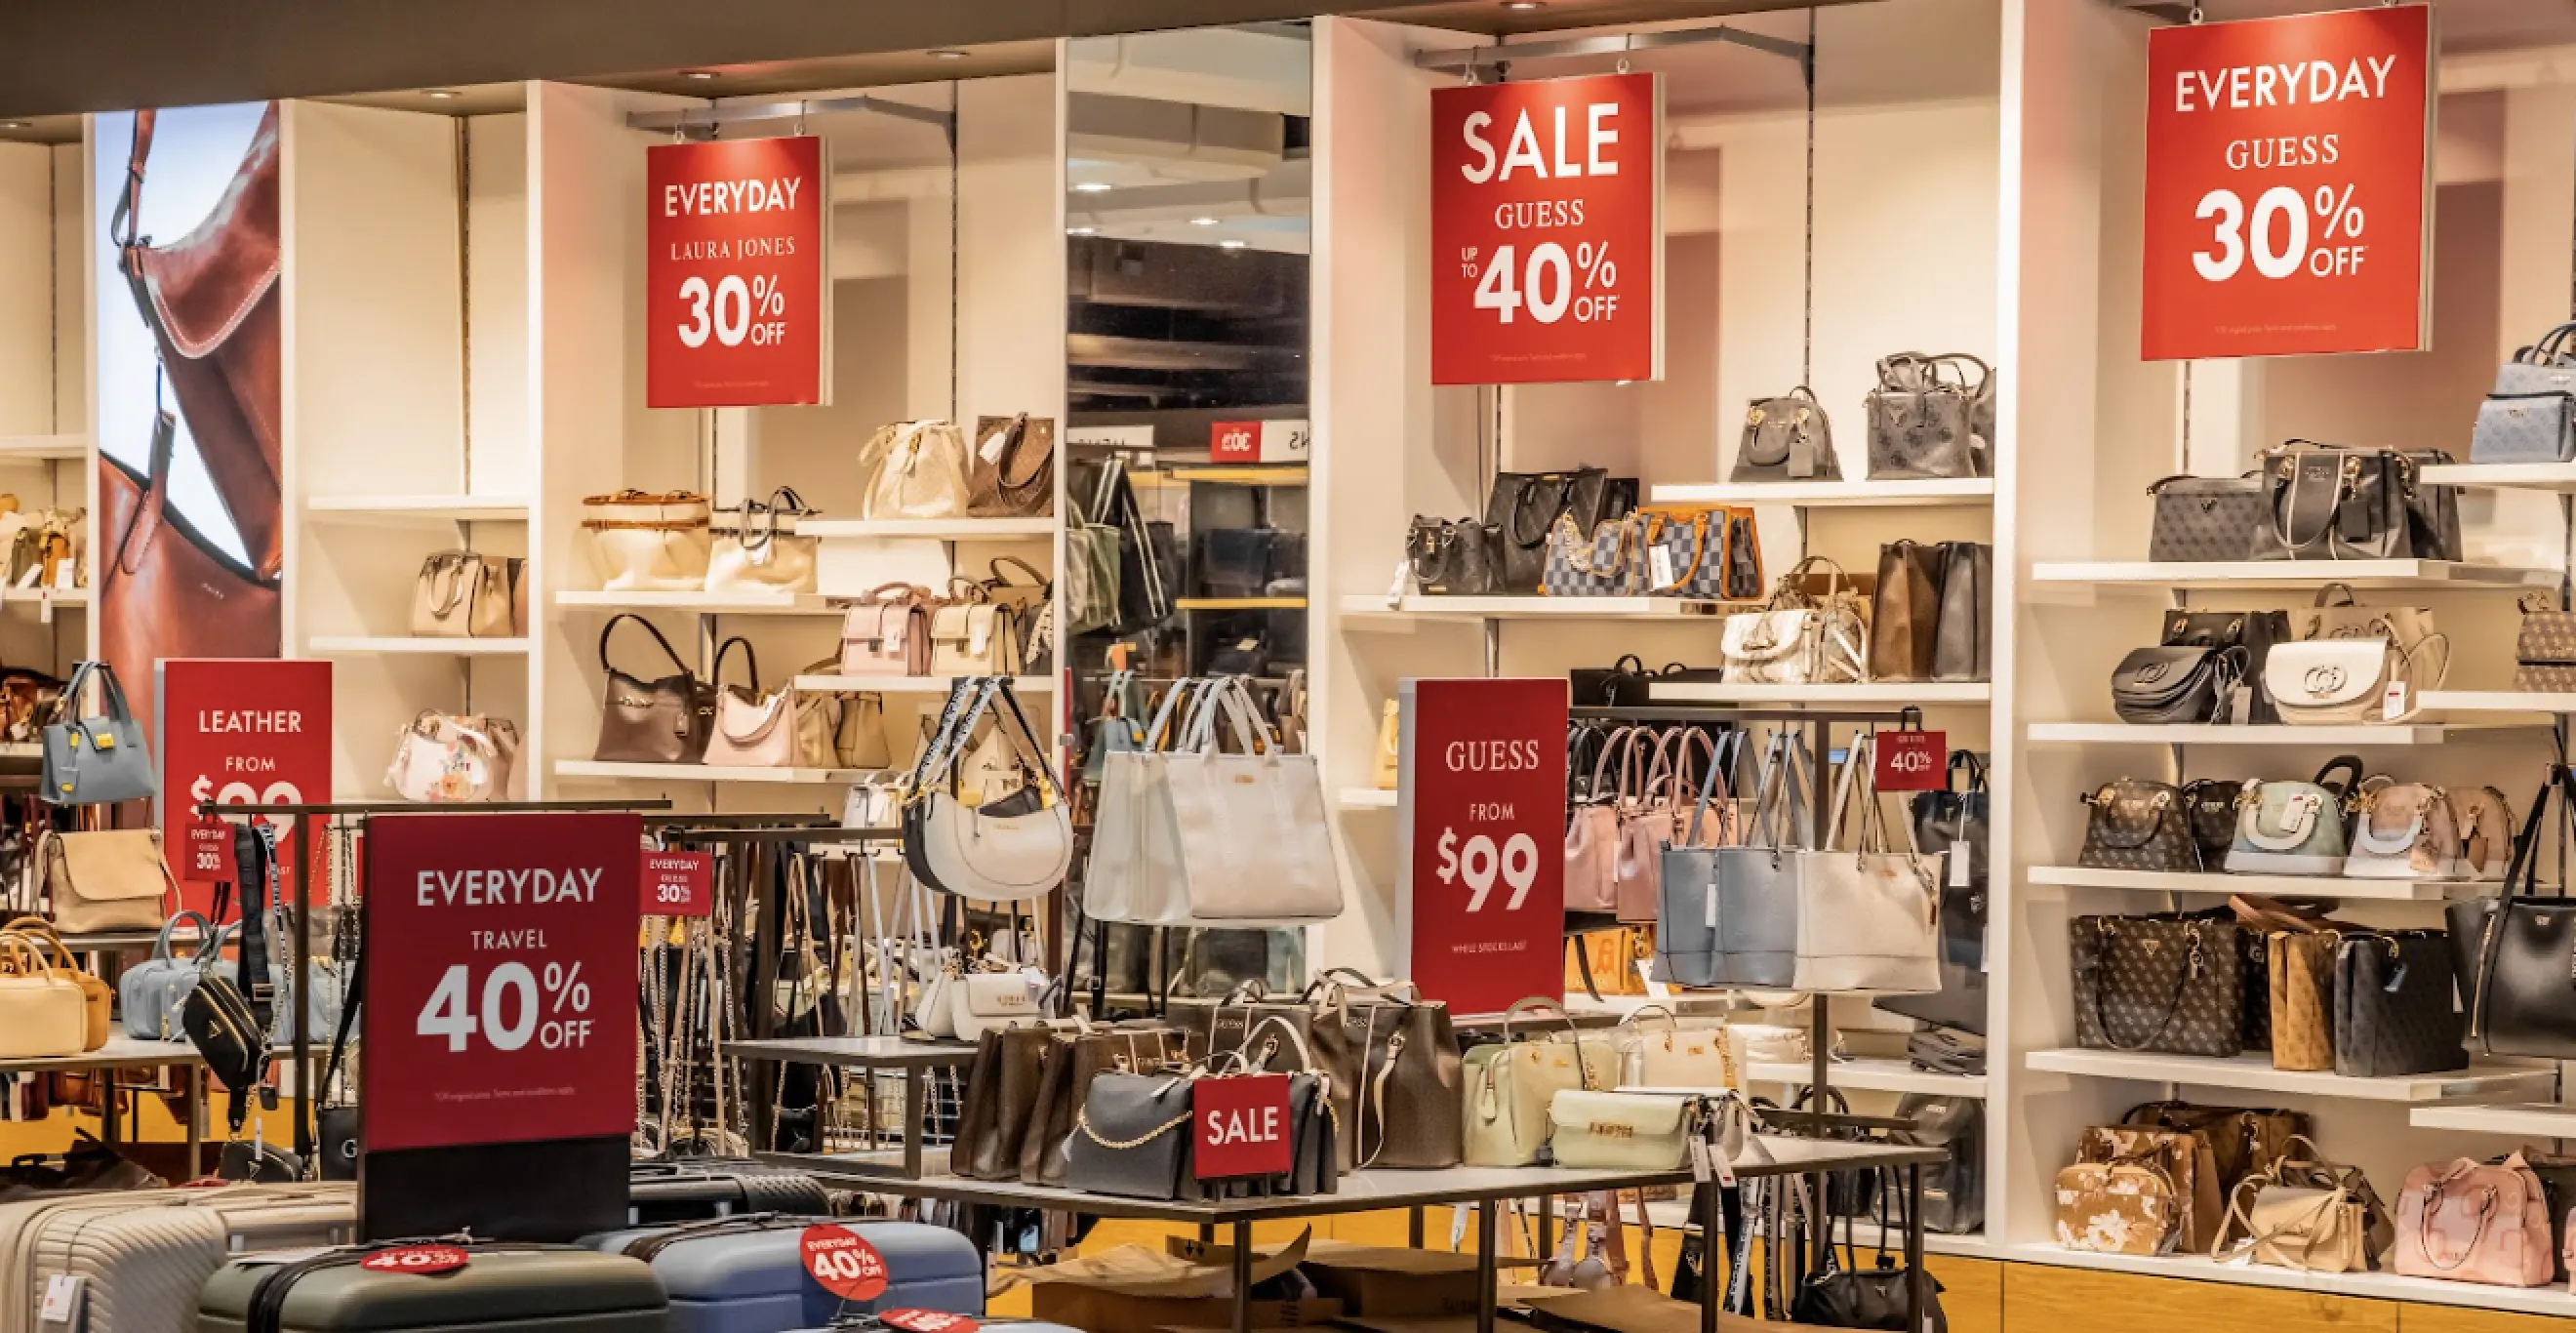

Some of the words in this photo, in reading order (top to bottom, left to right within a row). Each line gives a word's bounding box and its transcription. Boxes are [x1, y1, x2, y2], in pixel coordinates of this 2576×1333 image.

[2176, 54, 2396, 112] EVERYDAY
[1461, 102, 1620, 184] SALE
[2226, 134, 2339, 171] GUESS
[664, 176, 801, 217] EVERYDAY
[1494, 198, 1586, 229] GUESS
[670, 240, 731, 262] LAURA
[737, 235, 796, 261] JONES
[2192, 182, 2365, 282] 30%
[2310, 245, 2368, 278] OFF
[1461, 246, 1478, 261] UP
[1461, 263, 1478, 278] TO
[1473, 240, 1618, 325] 40%
[1574, 295, 1621, 323] OFF
[677, 273, 785, 348] 30%
[750, 321, 787, 346] OFF
[198, 709, 302, 734] LEATHER
[225, 756, 276, 772] FROM
[1445, 739, 1540, 772] GUESS
[1890, 750, 1933, 773] 40%
[1469, 801, 1515, 821] FROM
[649, 858, 700, 871] EVERYDAY
[1435, 826, 1539, 912] $99
[417, 867, 604, 907] EVERYDAY
[470, 928, 547, 950] TRAVEL
[417, 960, 591, 1053] 40%
[540, 1019, 593, 1050] OFF
[1207, 1106, 1279, 1146] SALE
[814, 1248, 876, 1281] 40%
